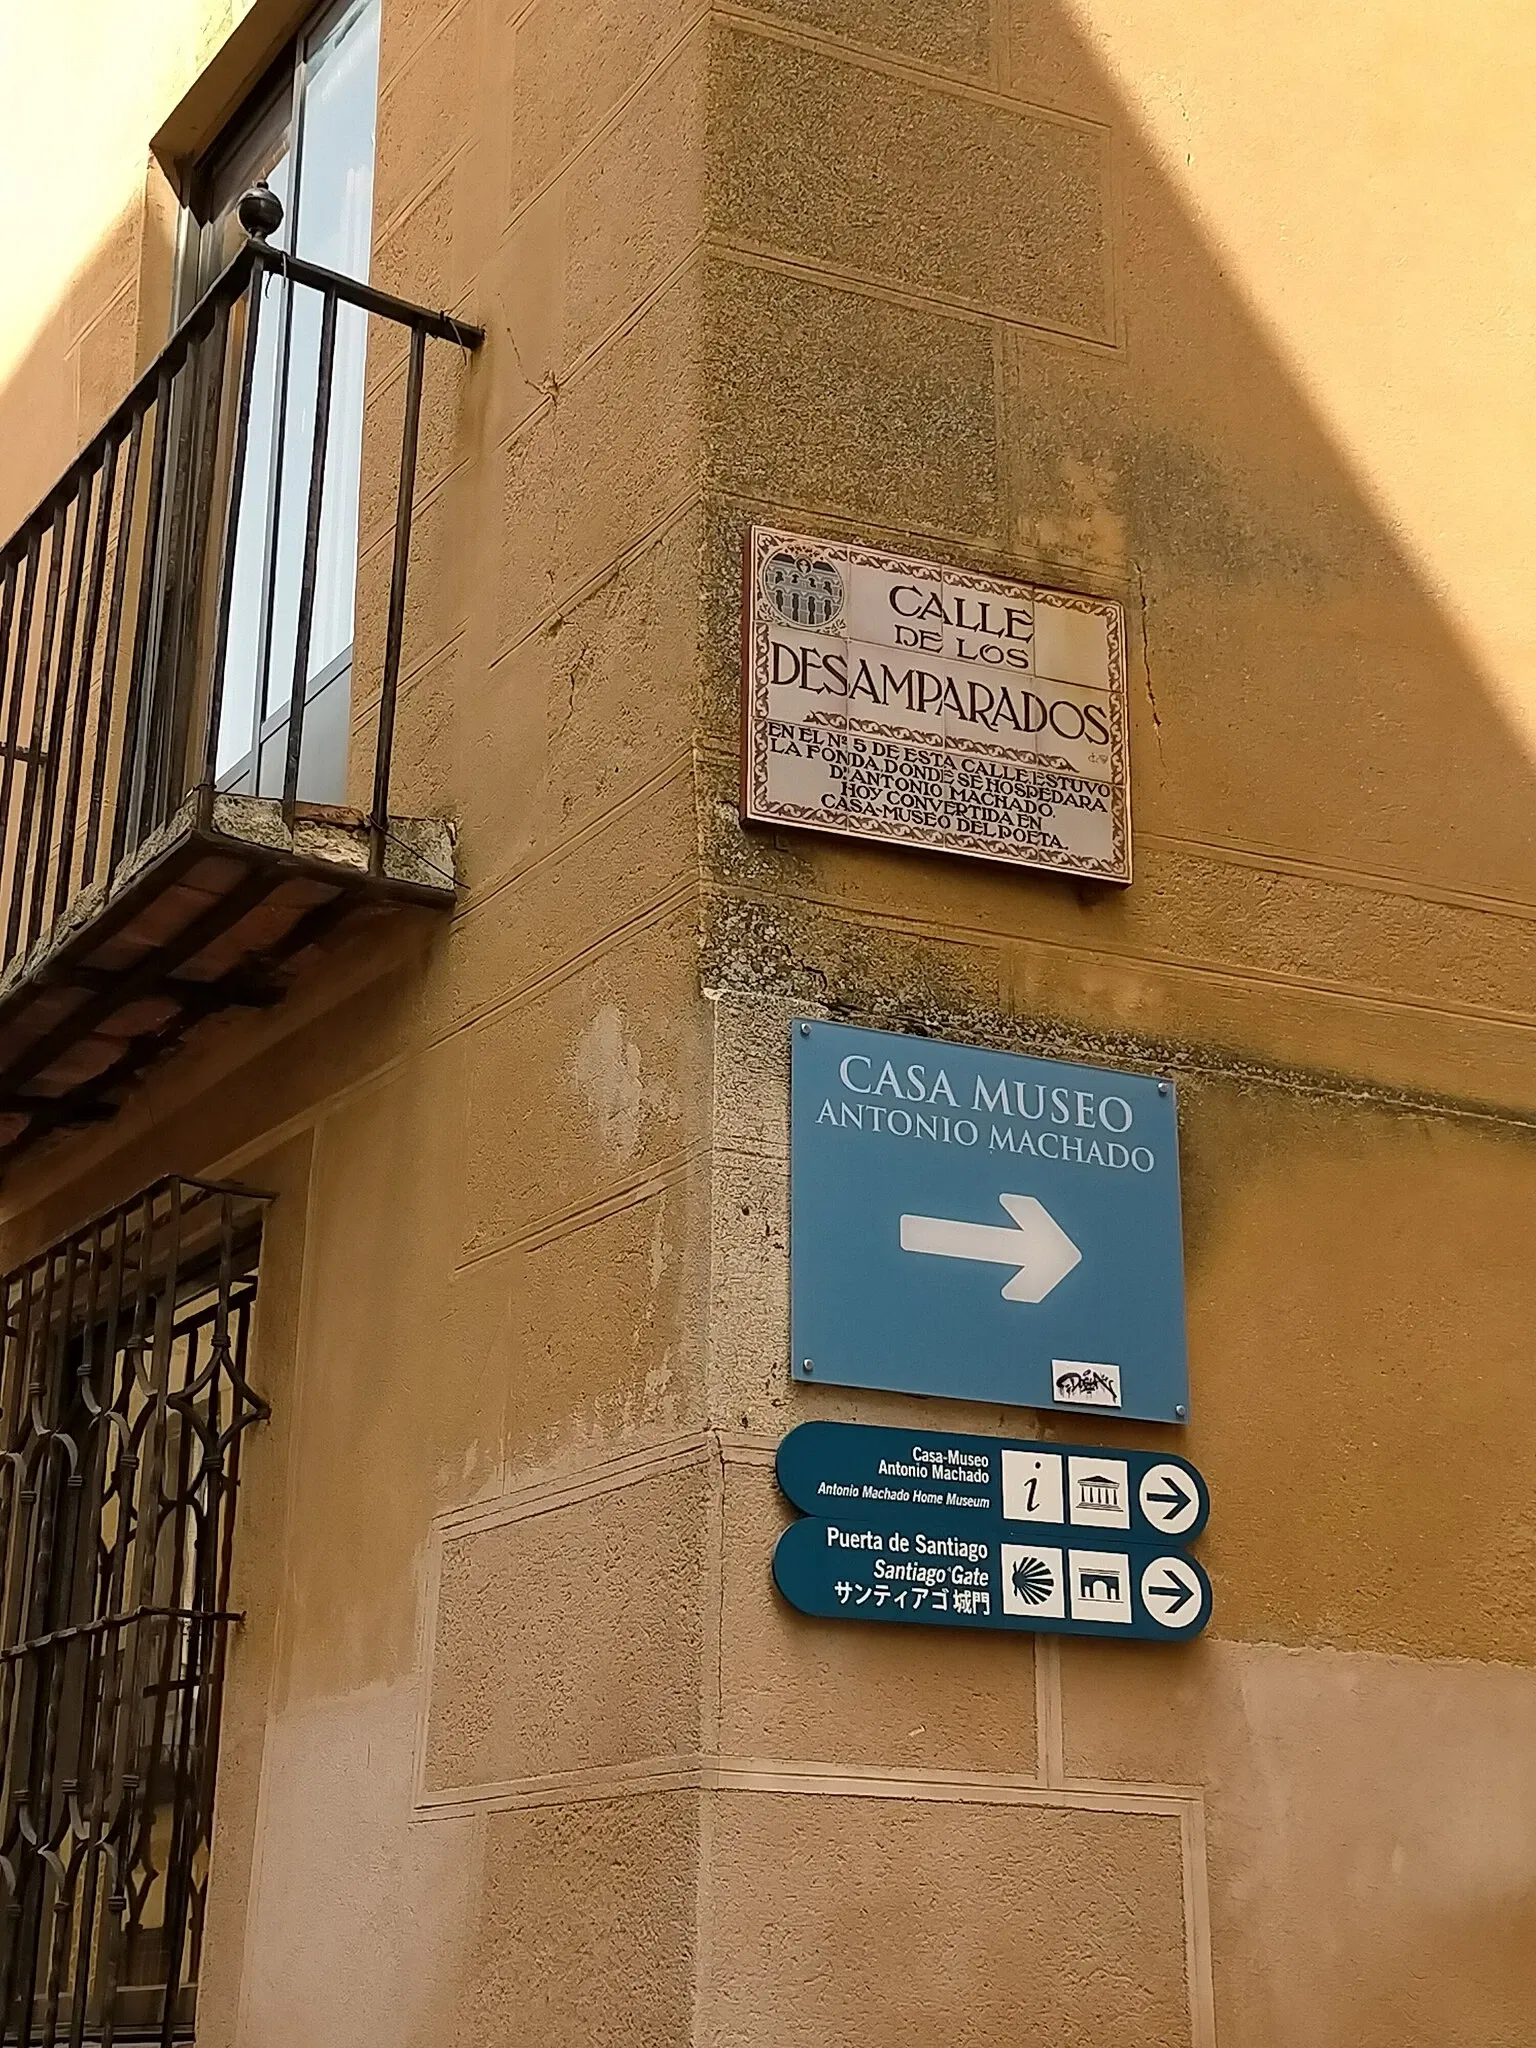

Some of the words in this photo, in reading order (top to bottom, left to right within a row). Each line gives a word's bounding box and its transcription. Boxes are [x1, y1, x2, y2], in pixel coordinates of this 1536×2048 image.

[888, 585, 1034, 644] CALLE
[894, 624, 943, 653] DE
[956, 638, 1029, 669] LOS
[770, 641, 1110, 745] DESAMPARADOS
[768, 721, 794, 740] EN
[799, 728, 825, 745] EL
[853, 738, 867, 753] 5
[872, 742, 900, 761] DE
[904, 747, 958, 771] ESTA
[1032, 770, 1111, 798] ESTUVO
[771, 738, 802, 757] LA
[884, 758, 954, 783] DONDE
[957, 772, 983, 790] SE
[985, 776, 1109, 813] HOSPEDARA
[849, 768, 942, 797] ANTONIO
[820, 793, 950, 830] CASA-MUSEO
[957, 817, 996, 838] DEL
[840, 781, 883, 801] HOY
[886, 790, 1014, 827] CONVERTIDA
[1016, 813, 1042, 831] EN
[839, 1054, 962, 1109] CASA
[971, 1074, 1134, 1134] MUSEO
[814, 1098, 979, 1147] ANTONIO
[988, 1124, 1155, 1173] MACHADO
[878, 1459, 928, 1478] Antonio
[931, 1464, 989, 1484] Machado
[912, 1446, 989, 1468] Casa-Museo
[817, 1481, 859, 1497] Antonio
[861, 1485, 910, 1502] Machado
[912, 1489, 943, 1505] Home
[946, 1492, 990, 1509] Museum
[827, 1526, 883, 1550] Puerta
[888, 1532, 909, 1552] de
[915, 1534, 988, 1563] Santiago
[873, 1558, 946, 1587] Santiago
[951, 1565, 989, 1587] Gate
